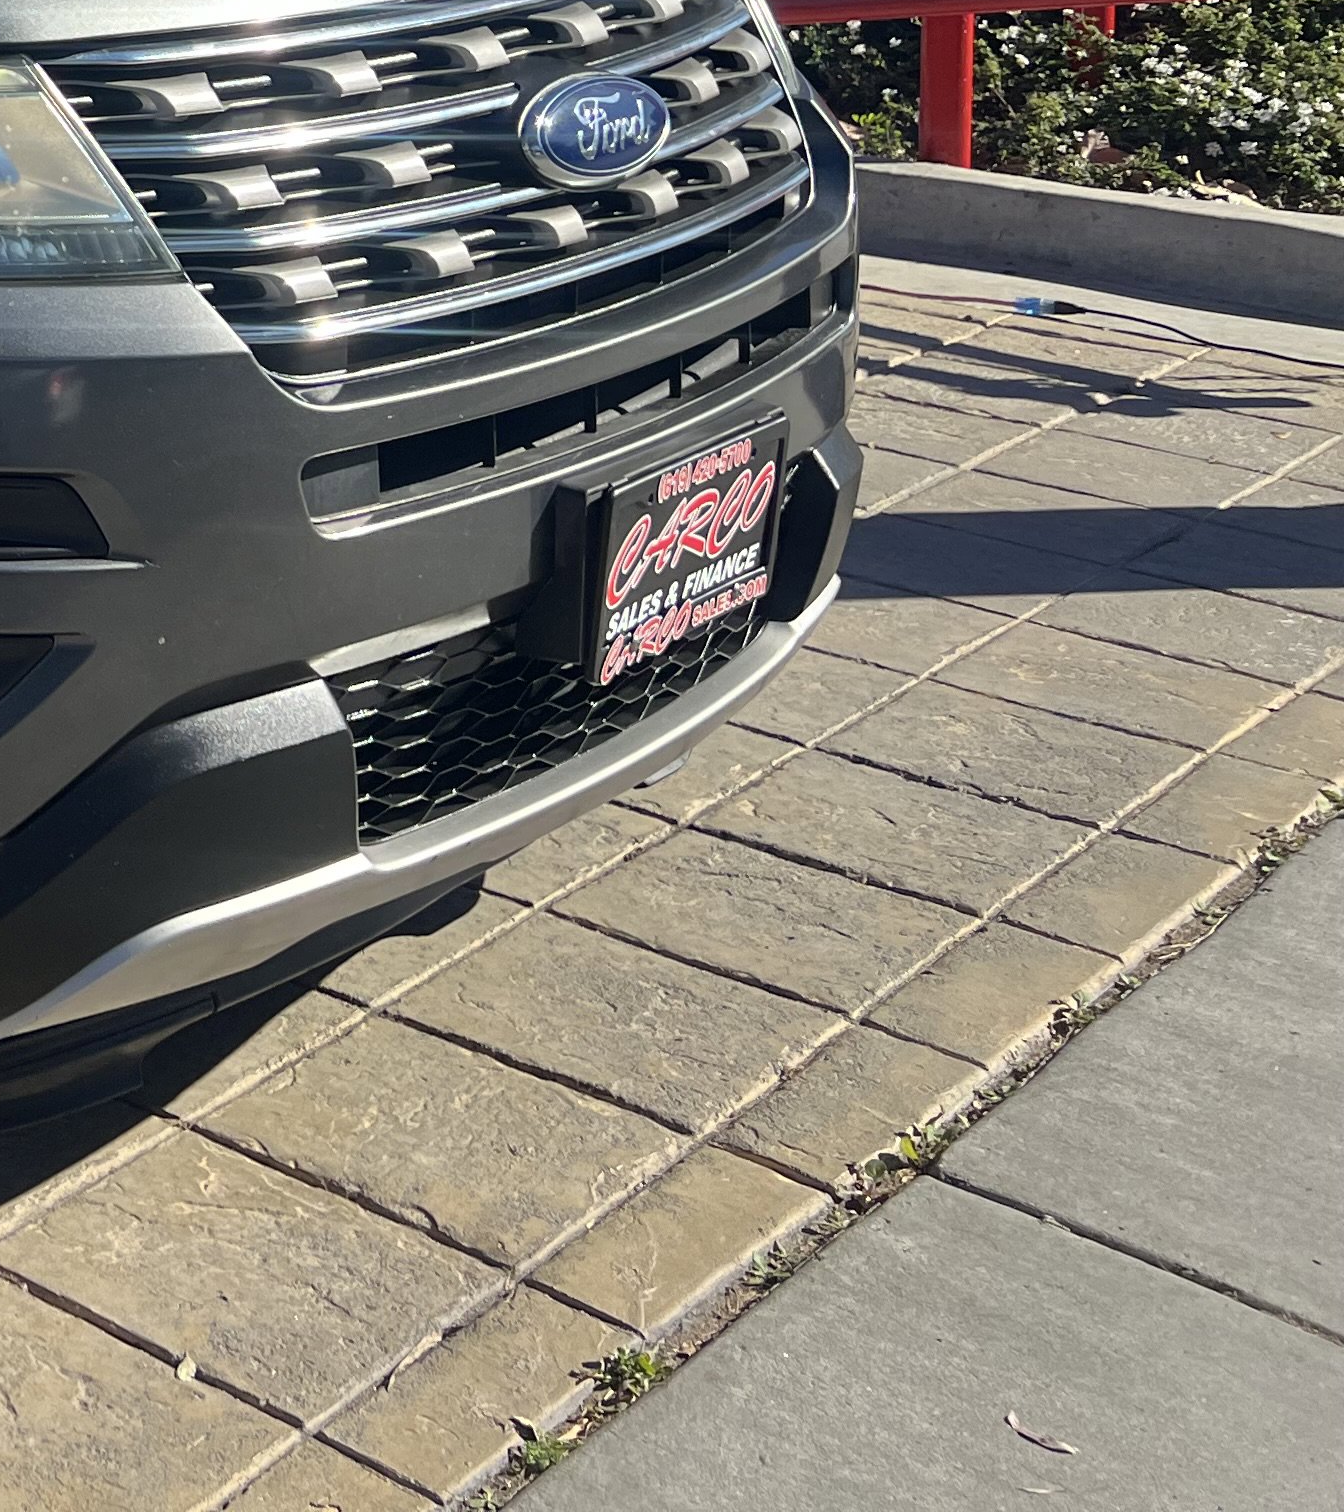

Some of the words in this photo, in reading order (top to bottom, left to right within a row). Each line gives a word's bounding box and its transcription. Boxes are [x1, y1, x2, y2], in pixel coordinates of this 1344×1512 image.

[574, 92, 649, 161] Ford
[658, 463, 691, 503] (619)
[692, 438, 752, 485] 420-5700
[605, 461, 775, 610] CARCO
[606, 589, 663, 640] SALES
[664, 581, 679, 606] &
[682, 542, 760, 598] FINANCE
